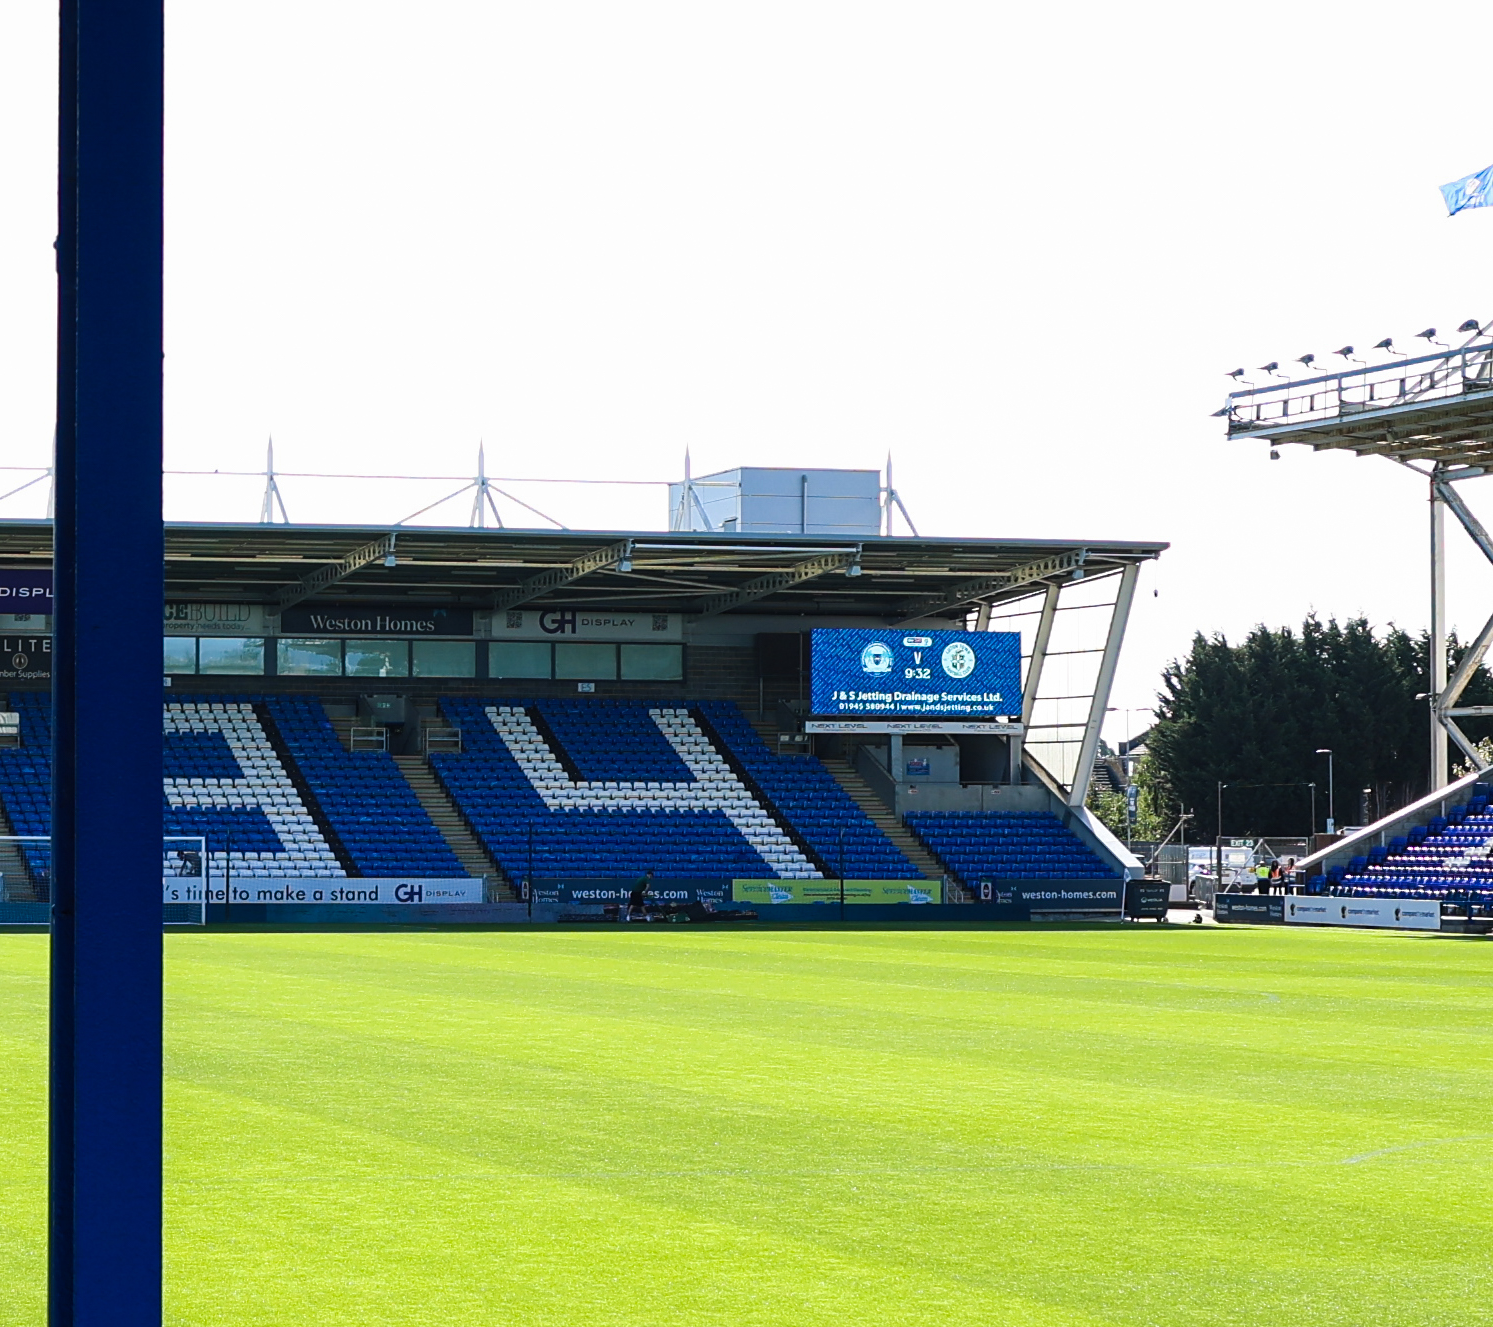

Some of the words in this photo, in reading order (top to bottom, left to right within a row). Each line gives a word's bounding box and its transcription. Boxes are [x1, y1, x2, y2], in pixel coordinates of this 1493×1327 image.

[310, 615, 372, 630] Weston
[376, 616, 435, 631] Homes
[538, 610, 577, 634] GH
[581, 618, 635, 627] DISPLAY
[913, 651, 922, 665] V
[18, 670, 51, 680] Supplies
[904, 668, 931, 680] 9:32
[832, 691, 838, 700] J
[839, 691, 848, 700] &
[849, 691, 856, 700] S
[857, 691, 892, 702] Jetting
[894, 692, 940, 702] Drainage
[941, 692, 982, 702] Services
[983, 692, 1003, 702] Ltd.
[230, 885, 250, 901] to
[257, 884, 306, 901] make
[313, 887, 324, 901] a
[330, 884, 379, 901] stand
[394, 883, 424, 903] GH
[1021, 889, 1117, 900] weston-homes.com
